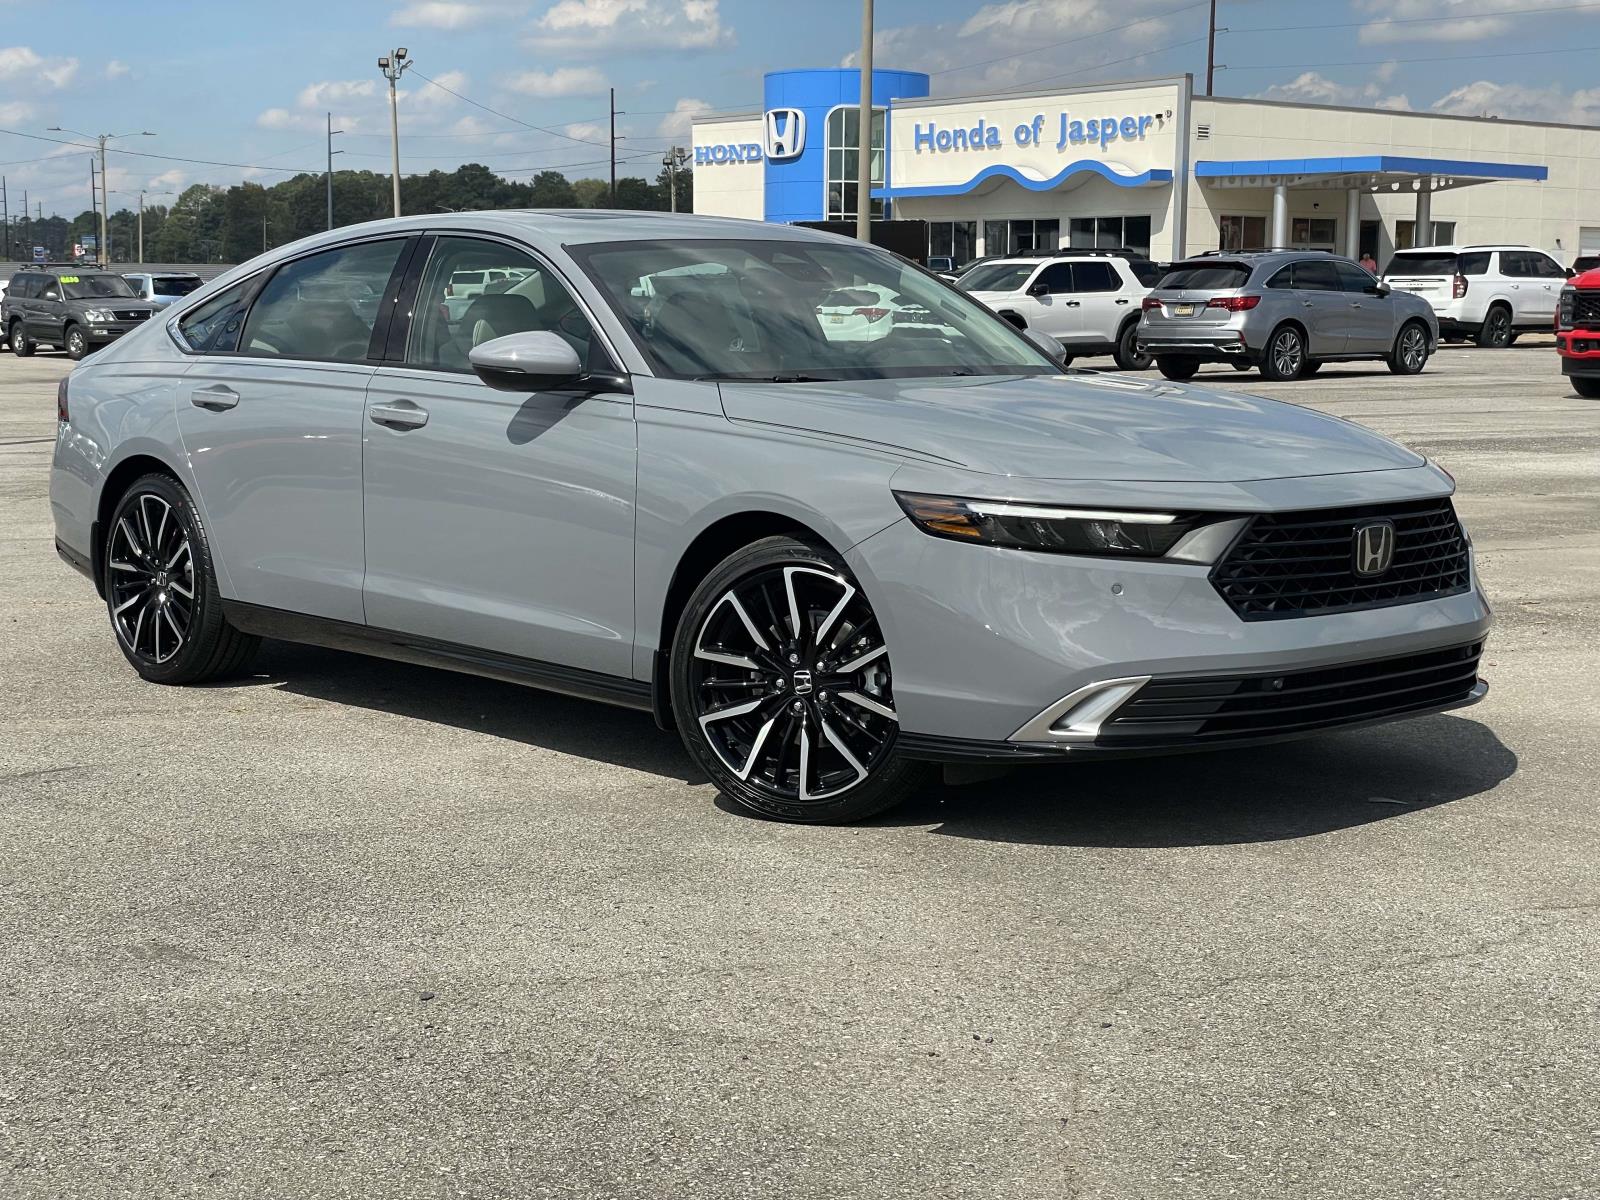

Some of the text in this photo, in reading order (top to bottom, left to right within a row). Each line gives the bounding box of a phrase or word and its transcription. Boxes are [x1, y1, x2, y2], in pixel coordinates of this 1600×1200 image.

[914, 112, 1153, 152] Honda of Jasper
[694, 143, 764, 163] HOND
